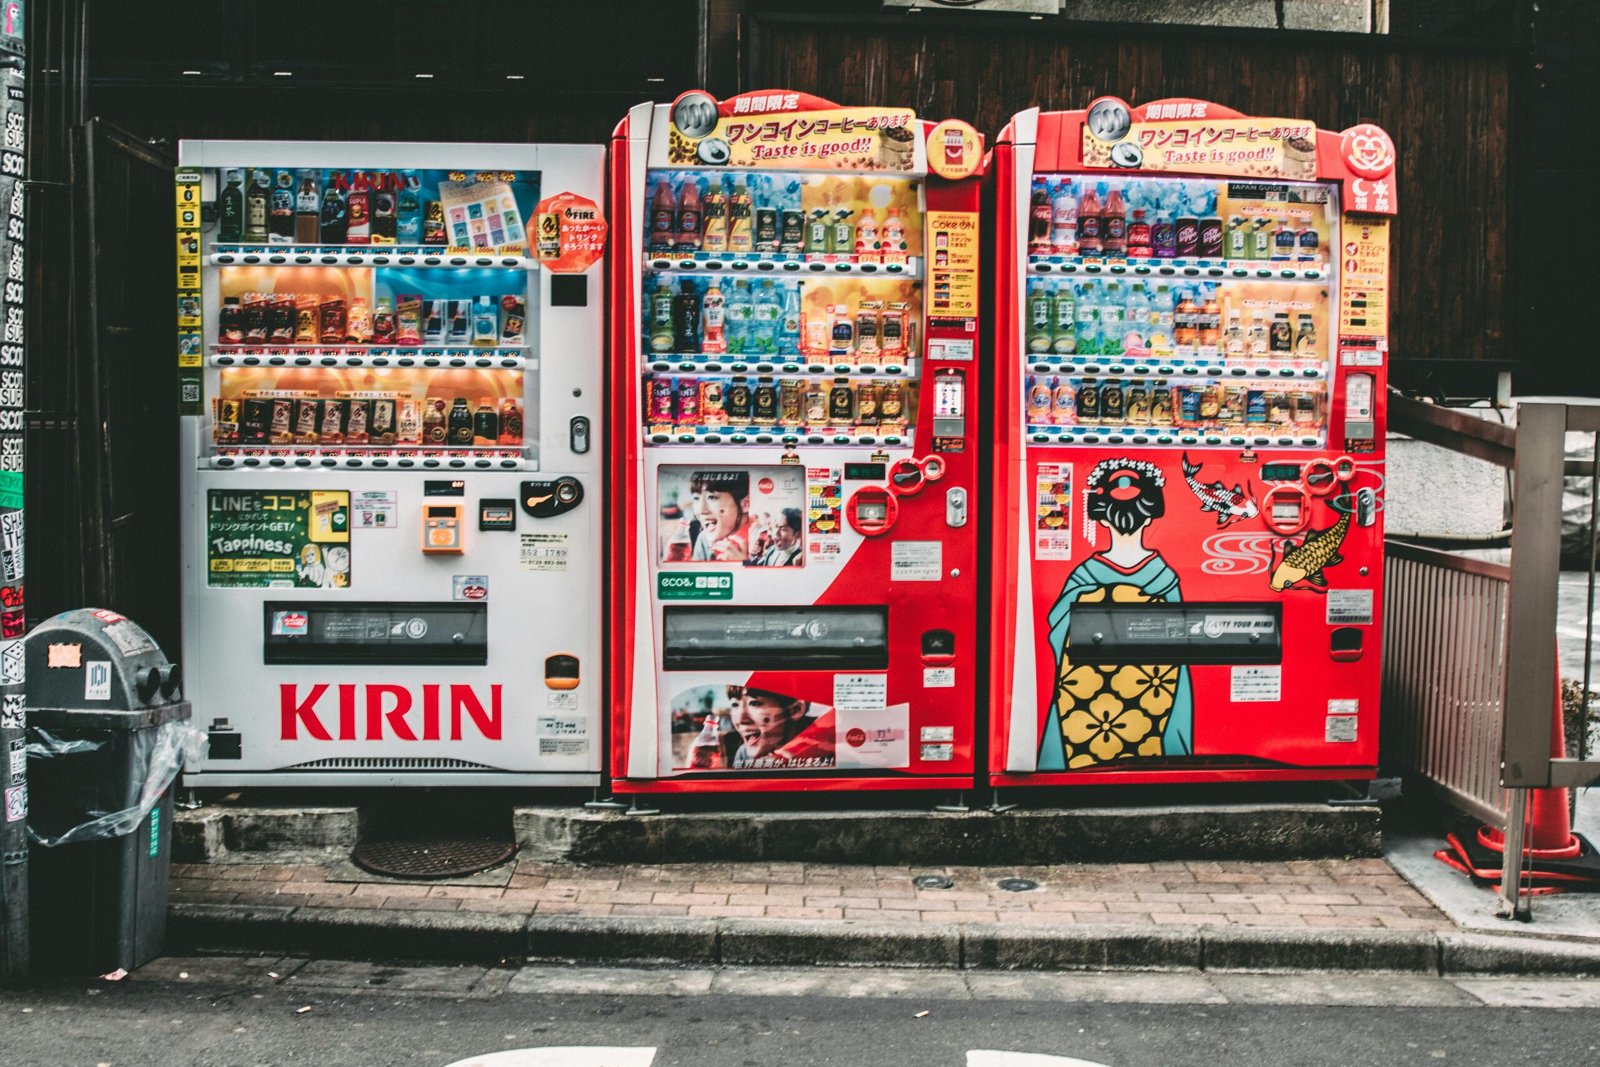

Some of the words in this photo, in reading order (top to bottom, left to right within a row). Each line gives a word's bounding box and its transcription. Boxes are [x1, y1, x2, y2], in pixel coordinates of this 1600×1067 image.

[733, 94, 799, 113] 期間限定
[1145, 103, 1207, 119] 期間限定
[726, 114, 911, 144] ワンコインコーヒーあります
[1139, 127, 1312, 147] ワンコインコーヒーあります
[753, 143, 798, 160] Taste
[803, 141, 817, 155] is
[821, 137, 872, 159] good!!
[1163, 150, 1207, 164] Taste
[1211, 148, 1225, 161] is
[1229, 147, 1276, 164] good!!
[335, 172, 407, 191] KIRIN
[573, 211, 596, 220] FIRE
[932, 220, 957, 229] Coke
[569, 233, 598, 242] ドリンク
[563, 242, 602, 252] そろってます
[210, 522, 295, 533] ドリンクポイントGET!
[212, 533, 294, 556] Tappiness
[1233, 620, 1252, 628] YOUR
[280, 683, 503, 741] KIRIN
